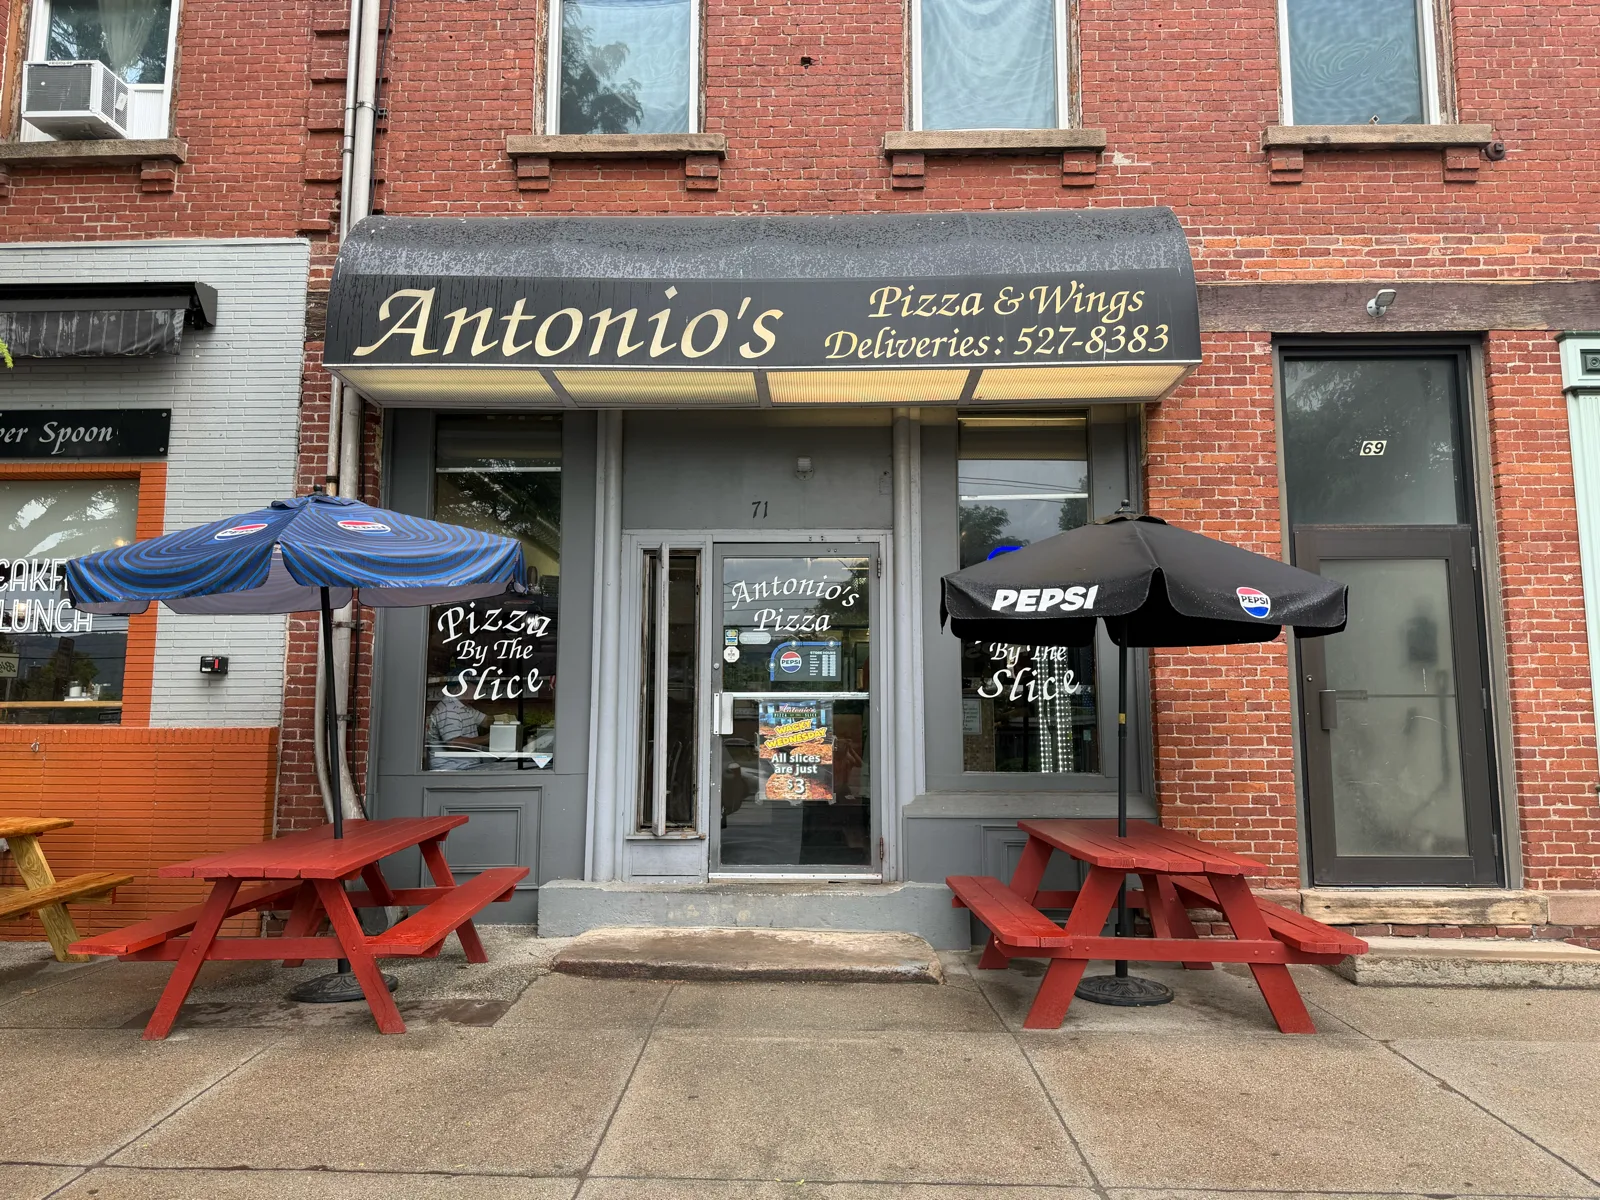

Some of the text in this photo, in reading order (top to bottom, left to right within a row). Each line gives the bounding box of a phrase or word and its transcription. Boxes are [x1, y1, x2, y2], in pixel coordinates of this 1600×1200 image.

[868, 280, 1146, 323] Pizza & Wings
[353, 285, 784, 360] Antonio's
[824, 324, 1169, 360] Deliveries: 527-8383
[38, 421, 114, 455] Spoon
[1362, 441, 1385, 455] 69
[751, 500, 768, 519] 71
[0, 558, 69, 592] EAKF
[731, 575, 860, 610] Antonio's
[991, 585, 1099, 612] PEPSI
[1240, 595, 1269, 605] PEPSI
[0, 598, 93, 633] LUNCH
[437, 601, 552, 644] Pizza
[752, 607, 832, 632] Pizza
[456, 636, 534, 667] By The
[989, 642, 1021, 668] By
[441, 666, 544, 701] Slice
[977, 667, 1080, 703] Slice
[765, 728, 827, 748] WEDNESDAY
[775, 719, 812, 735] WACKY
[771, 753, 821, 763] All slices
[774, 763, 818, 776] are just
[787, 778, 805, 794] $3
